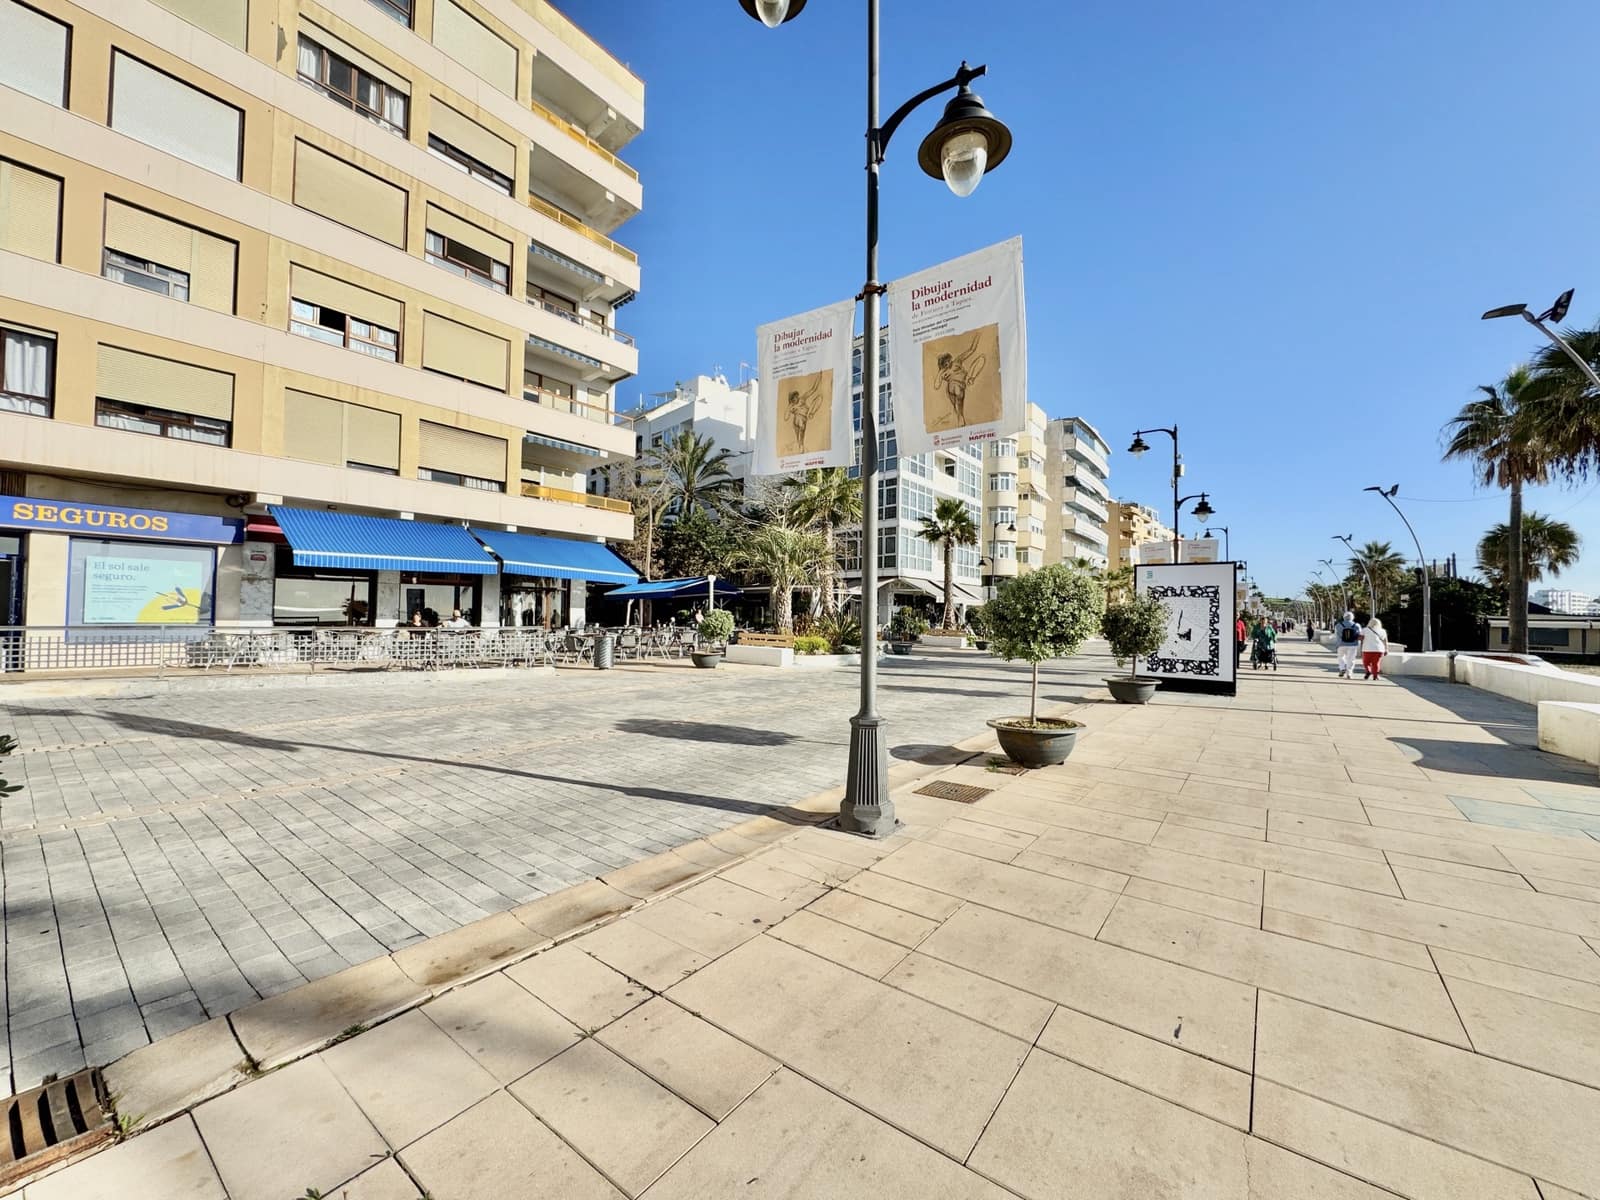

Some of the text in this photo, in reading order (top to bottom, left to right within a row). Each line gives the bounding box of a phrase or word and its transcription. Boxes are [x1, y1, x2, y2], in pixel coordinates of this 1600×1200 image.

[911, 280, 953, 300] Dibujar
[911, 275, 992, 311] la modernidad
[774, 328, 805, 343] Dibujar
[774, 344, 781, 352] la
[782, 328, 833, 349] modernidad
[968, 432, 996, 441] MAPFRE
[12, 502, 169, 532] SEGUROS
[94, 561, 151, 572] El sol sale
[93, 572, 136, 582] seguro.
